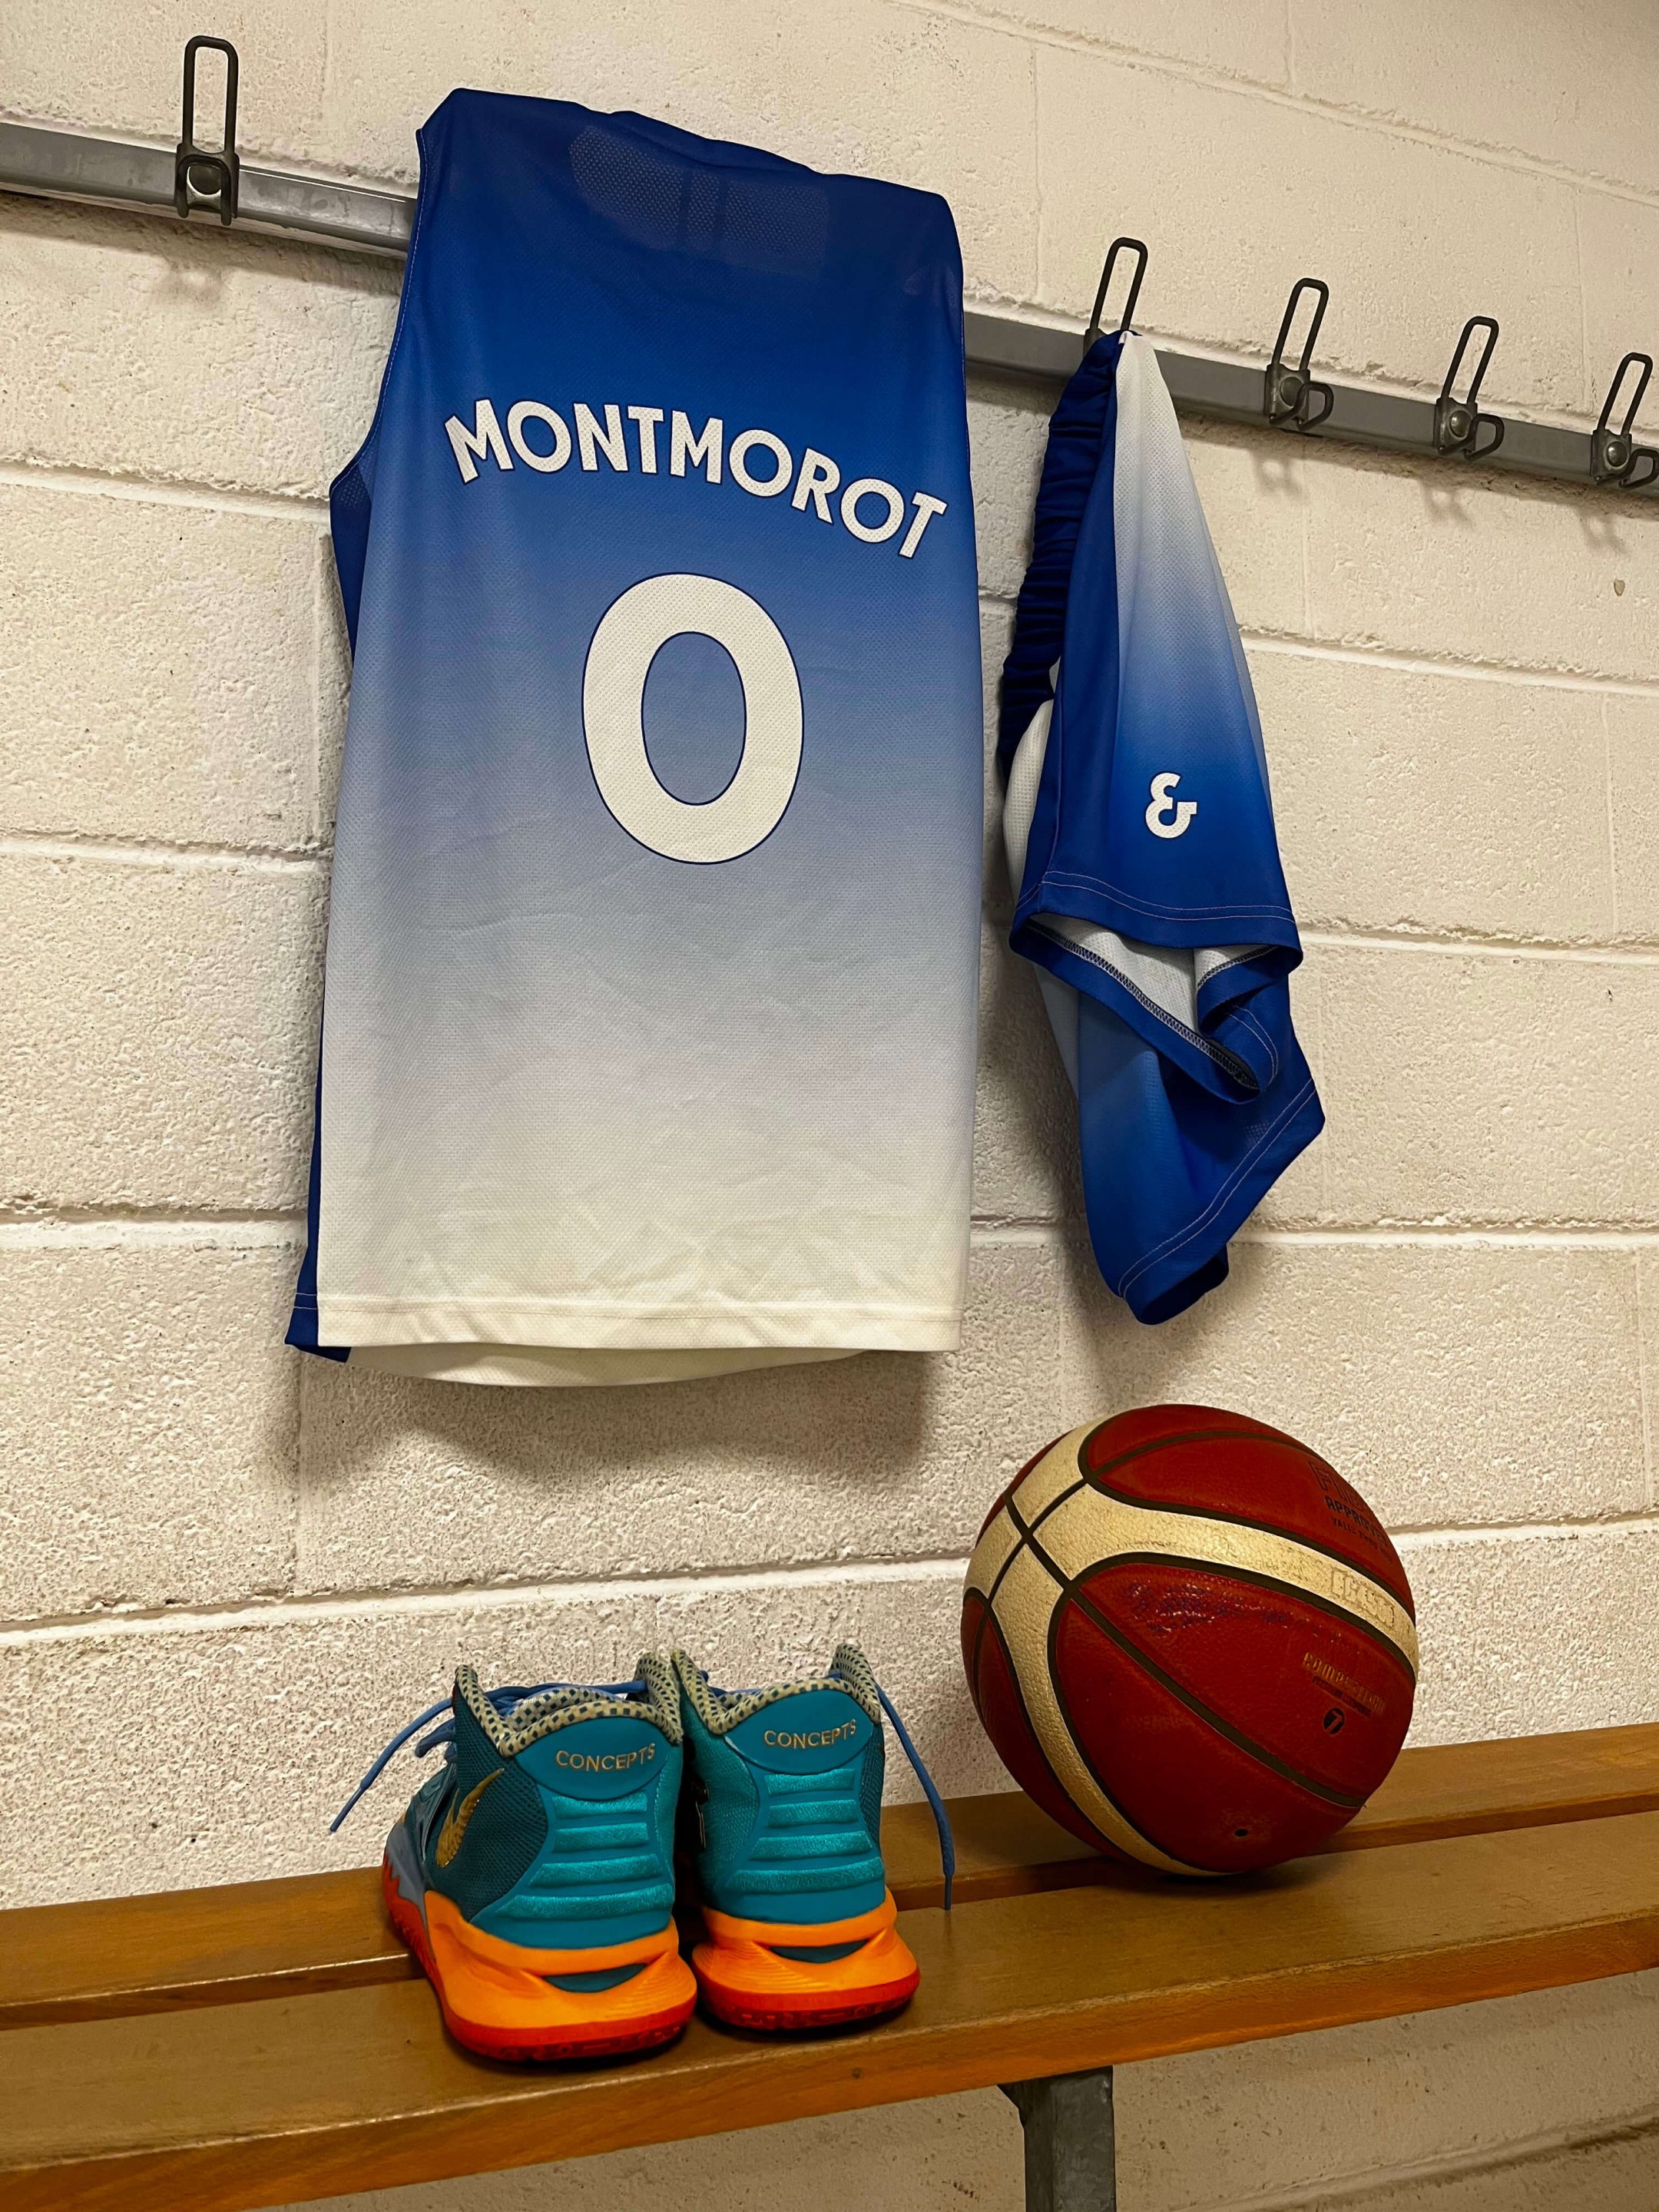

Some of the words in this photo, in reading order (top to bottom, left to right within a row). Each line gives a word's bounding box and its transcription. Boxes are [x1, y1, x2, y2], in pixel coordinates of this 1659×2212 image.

[443, 398, 949, 560] MONTMOROT
[581, 572, 804, 863] 0
[1144, 771, 1198, 839] &
[763, 1718, 856, 1750] CONCEPTS
[1323, 1709, 1344, 1735] 7
[555, 1742, 656, 1773] CONCEPTS
